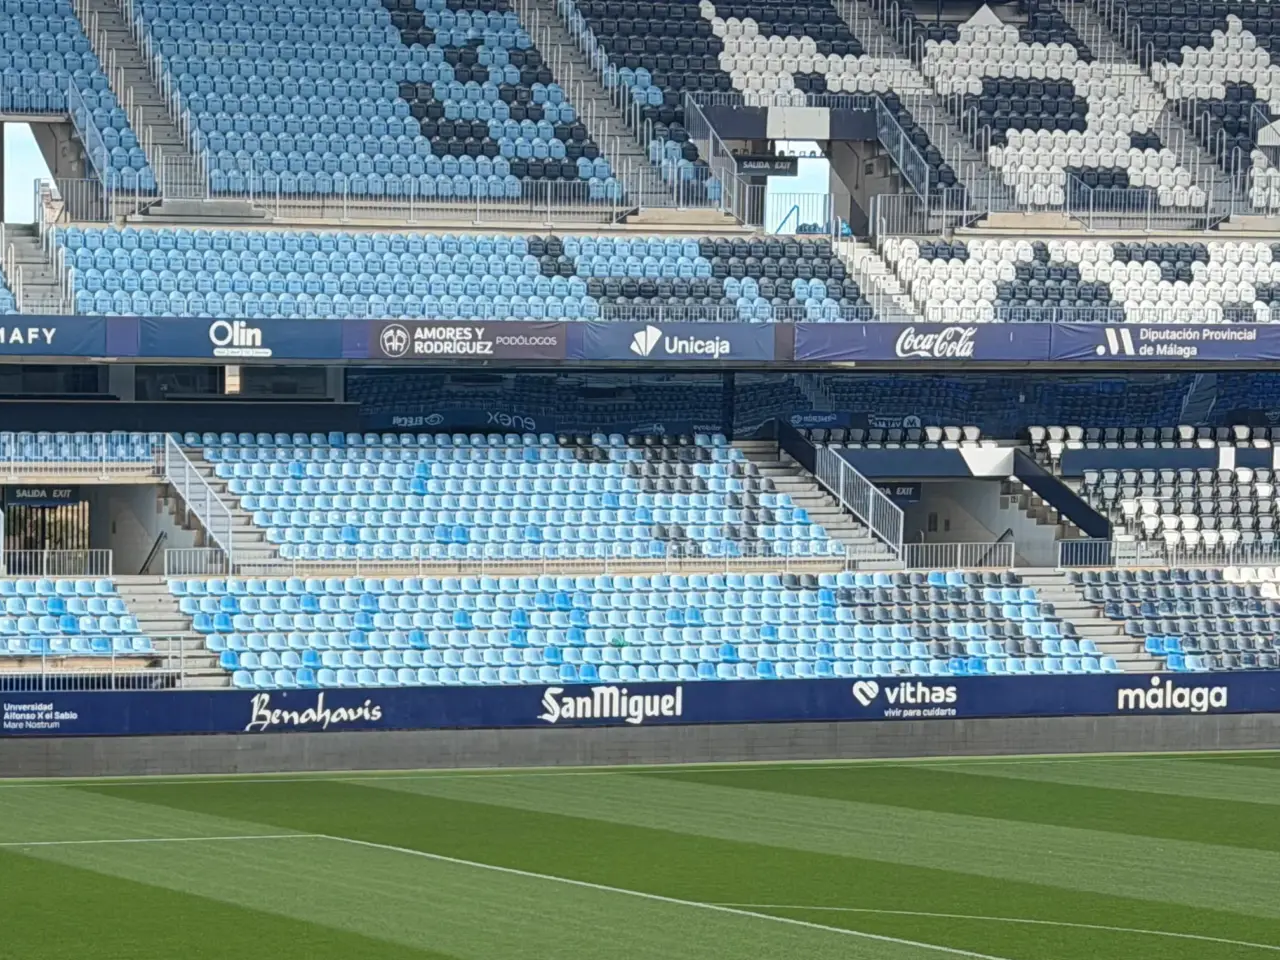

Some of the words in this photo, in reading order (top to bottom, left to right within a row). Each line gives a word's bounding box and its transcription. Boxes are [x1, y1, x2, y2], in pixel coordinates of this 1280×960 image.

[743, 160, 770, 169] SALIDA
[775, 161, 791, 170] EXIT
[209, 320, 262, 346] Olin
[414, 327, 473, 340] AMORES
[475, 328, 485, 339] Y
[1140, 328, 1200, 343] Diputación
[1202, 328, 1257, 342] Provincial
[414, 340, 493, 355] RODRÍGUEZ
[496, 335, 557, 347] PODÓLOGOS
[665, 335, 730, 358] Unicaja
[895, 326, 978, 358] Coca-Cola
[1139, 345, 1154, 356] de
[1156, 343, 1198, 358] Málaga
[16, 489, 47, 498] SALIDA
[52, 489, 72, 498] EXIT
[896, 487, 914, 496] EXIT
[884, 681, 958, 704] vithas
[3, 702, 54, 711] Universidad
[884, 708, 901, 717] vivir
[903, 710, 921, 719] para
[922, 706, 957, 717] cuidarte
[4, 711, 36, 720] Alfonso
[37, 711, 44, 720] X
[44, 711, 53, 720] el
[54, 711, 78, 720] Sabio
[3, 720, 24, 729] Mare
[25, 720, 60, 729] Nostrum
